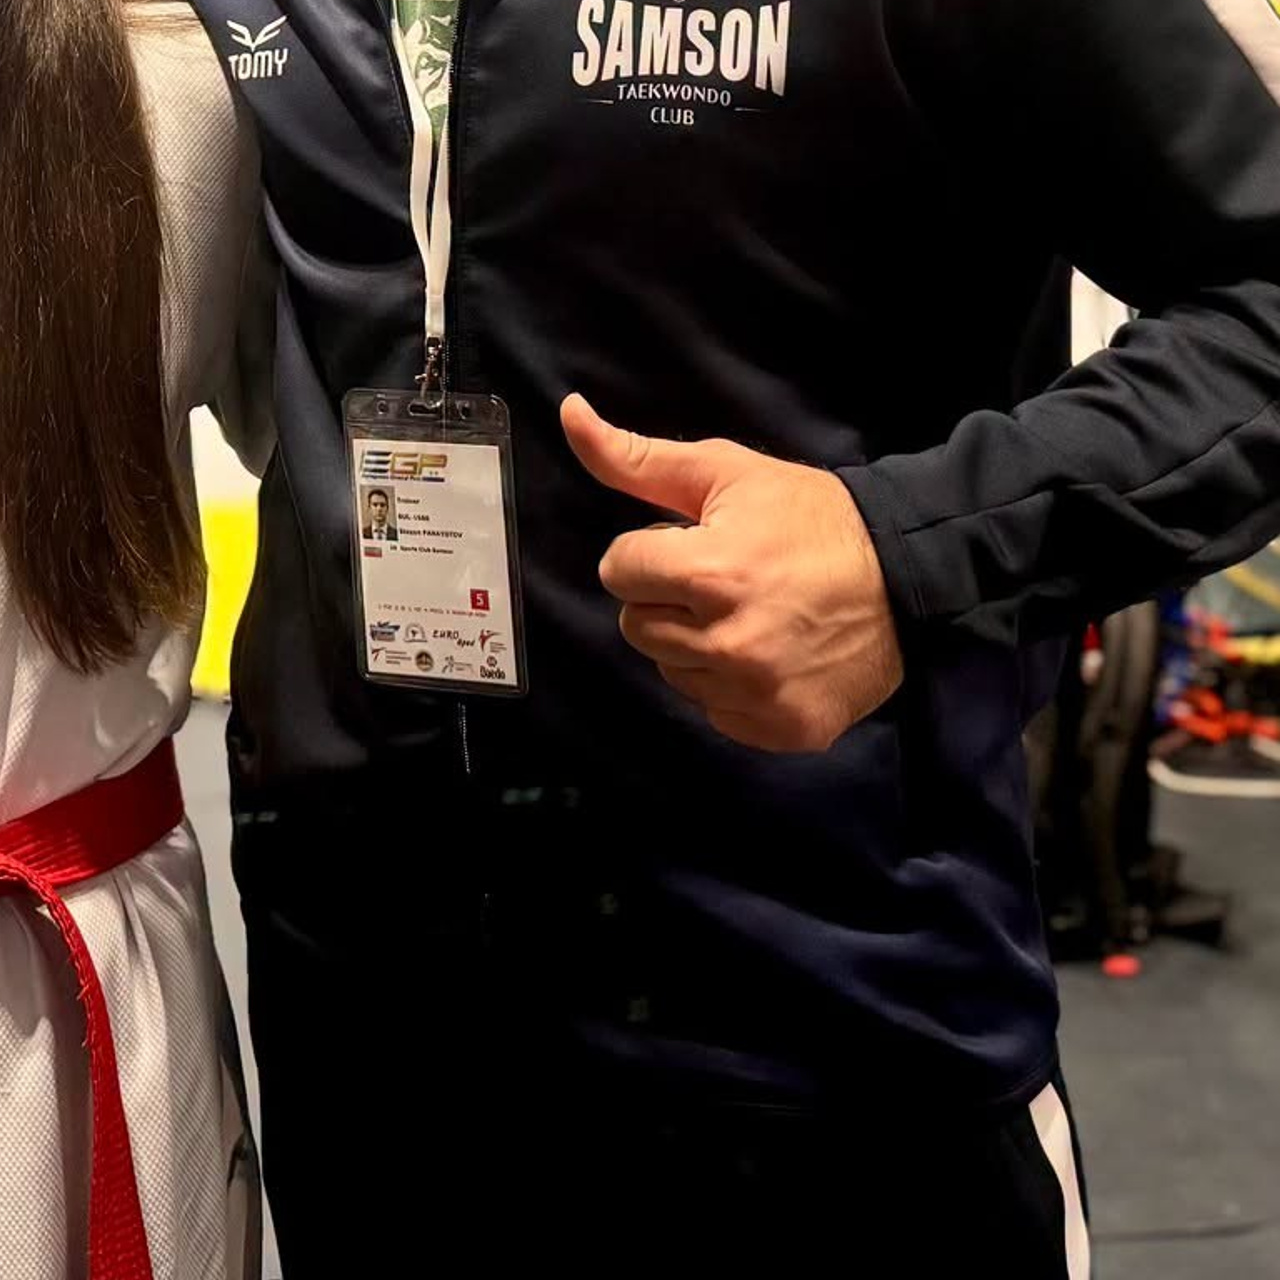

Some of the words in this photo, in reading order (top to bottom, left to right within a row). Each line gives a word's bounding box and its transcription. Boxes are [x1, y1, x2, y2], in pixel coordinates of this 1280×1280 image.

[227, 47, 289, 81] TOMY
[618, 82, 732, 107] TAEKWONDO
[650, 106, 696, 125] CLUB
[475, 593, 485, 606] 5
